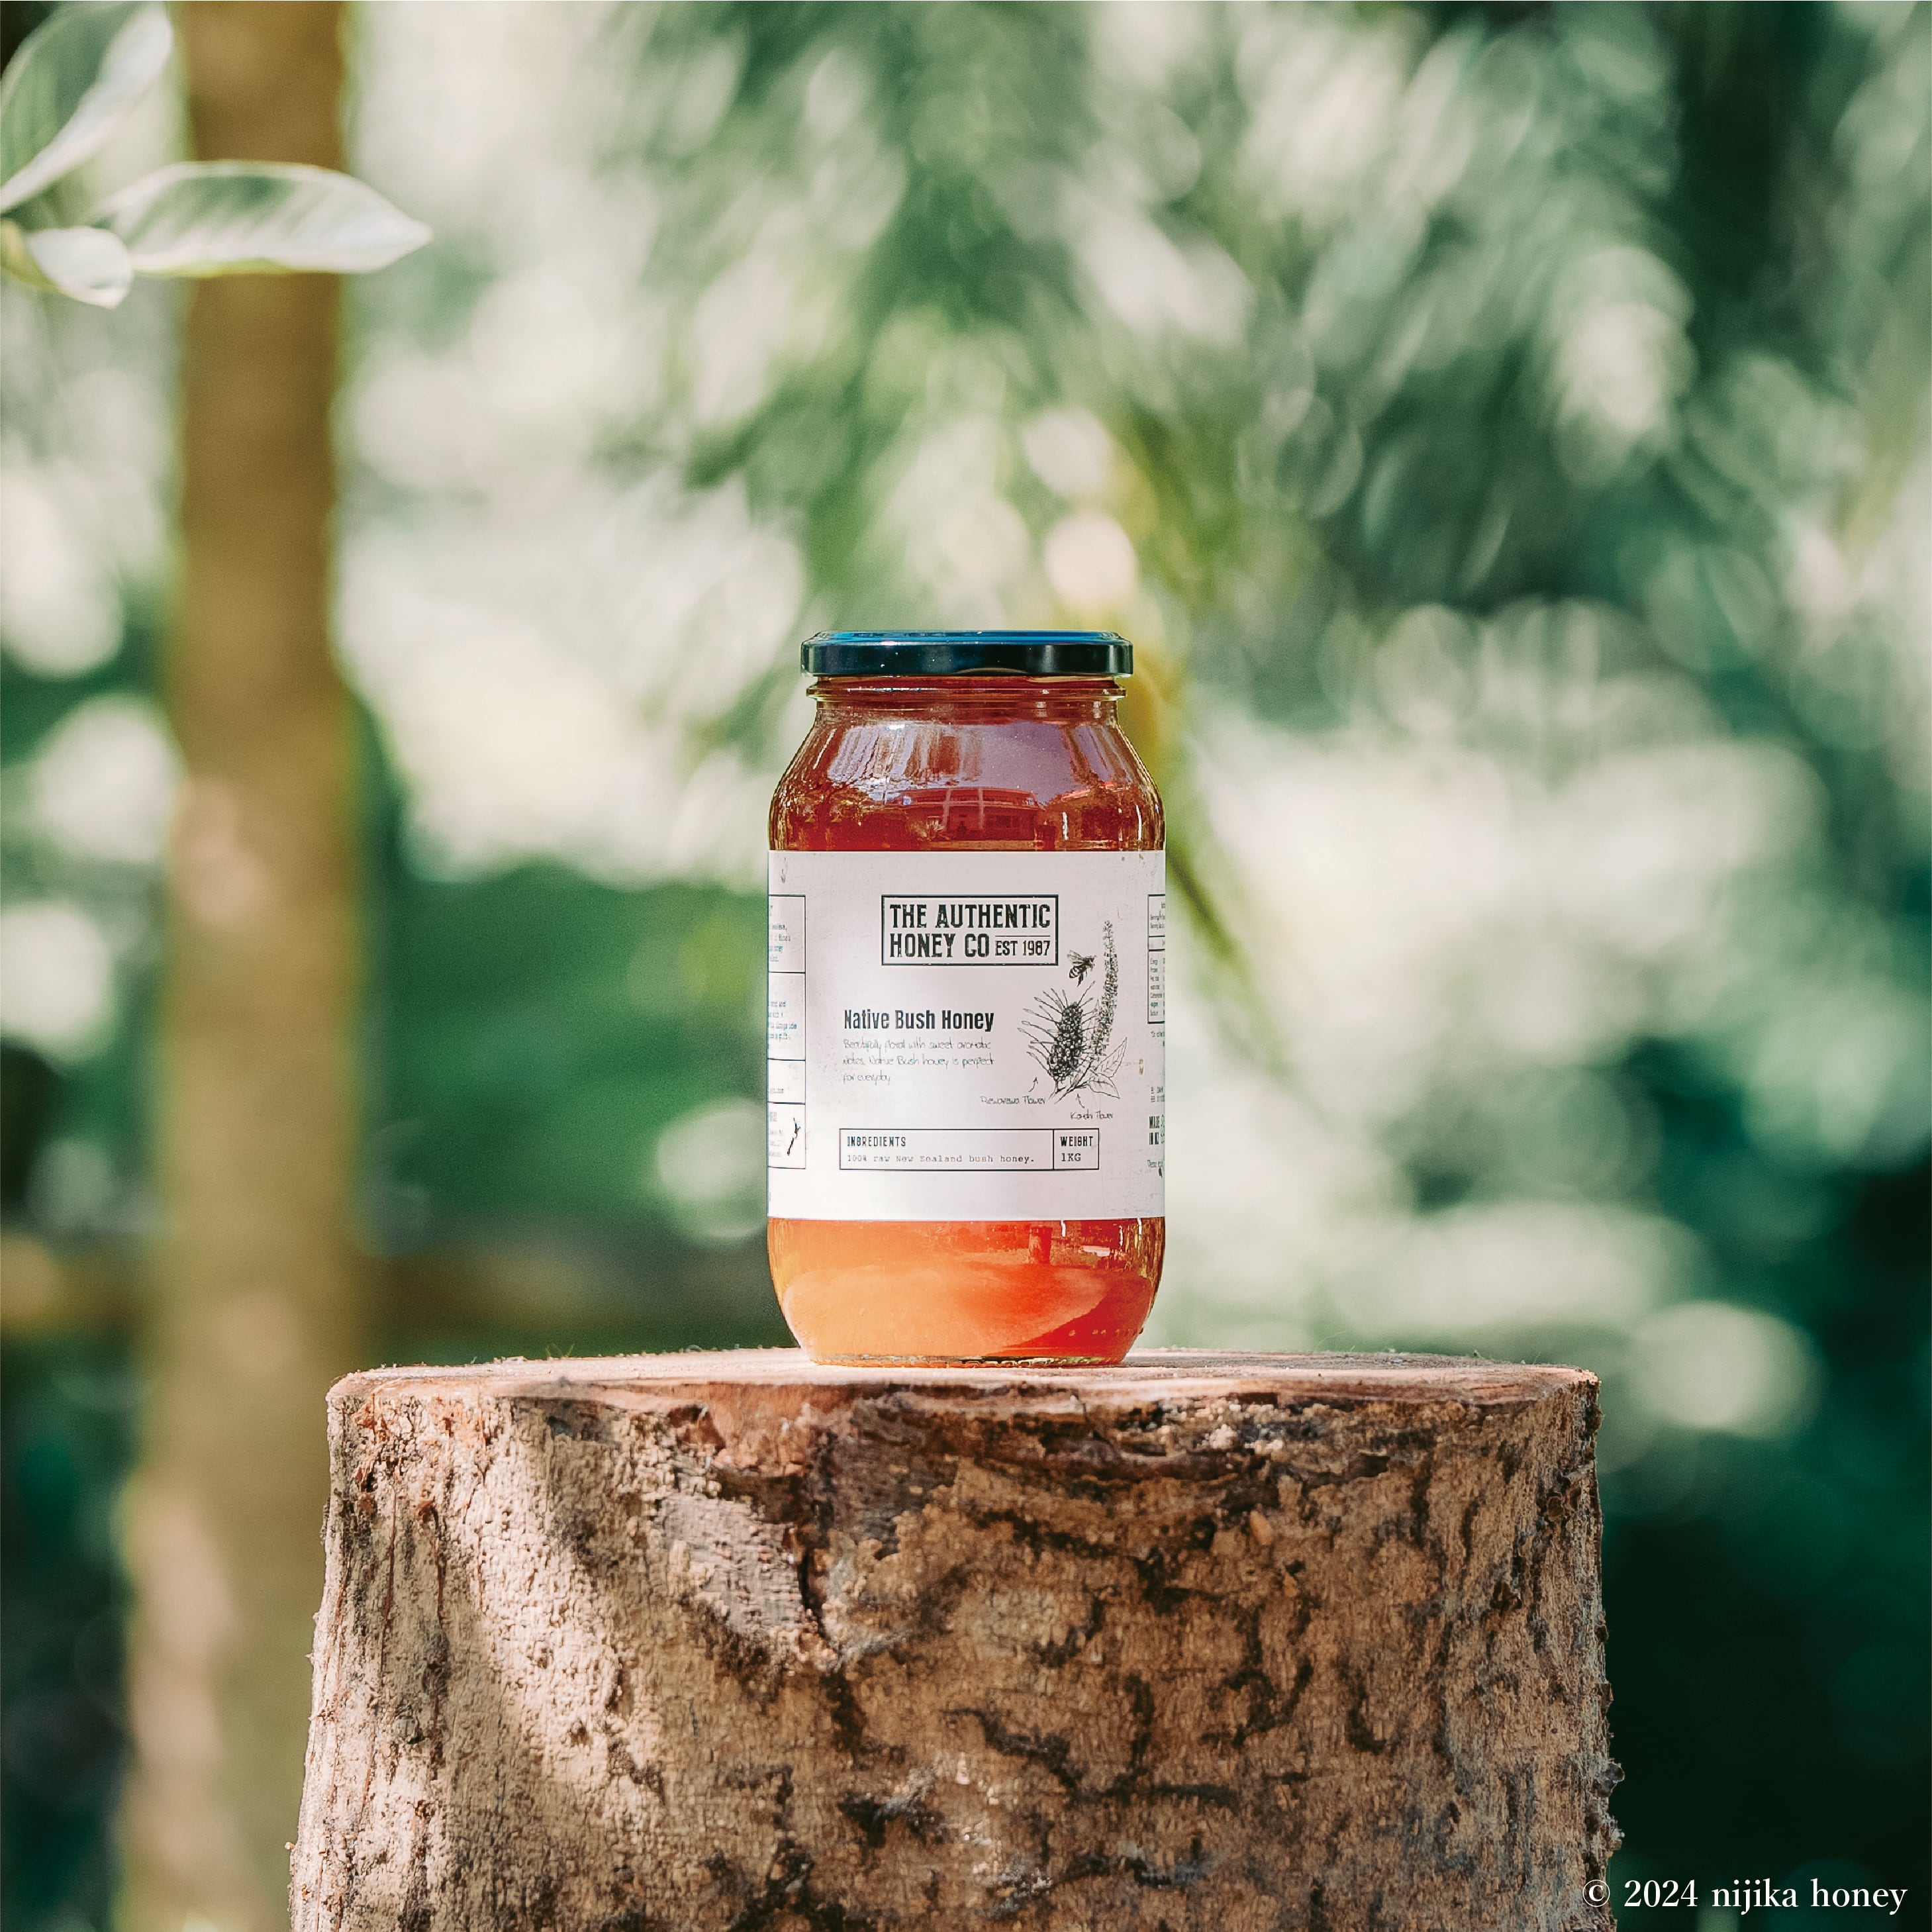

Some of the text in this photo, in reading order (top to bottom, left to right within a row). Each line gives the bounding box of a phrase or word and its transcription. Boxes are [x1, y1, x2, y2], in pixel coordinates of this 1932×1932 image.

[890, 904, 1051, 928] THE AUTHENTIC
[890, 933, 1051, 957] HONEY CO EST 1987
[844, 1008, 994, 1032] Native Bush Honey
[843, 1037, 882, 1054] Beautifully
[908, 1036, 926, 1049] with
[929, 1036, 953, 1049] sweet
[957, 1036, 992, 1049] aromatic
[869, 1055, 894, 1065] Native
[897, 1053, 920, 1065] Bush
[922, 1053, 949, 1069] honey
[962, 1052, 995, 1069] perfect
[843, 1073, 855, 1085] for
[847, 1136, 906, 1147] INGREDIENTS
[1059, 1135, 1094, 1147] WEIGHT
[1000, 1155, 1034, 1164] honey.
[1061, 1153, 1082, 1162] 1KG
